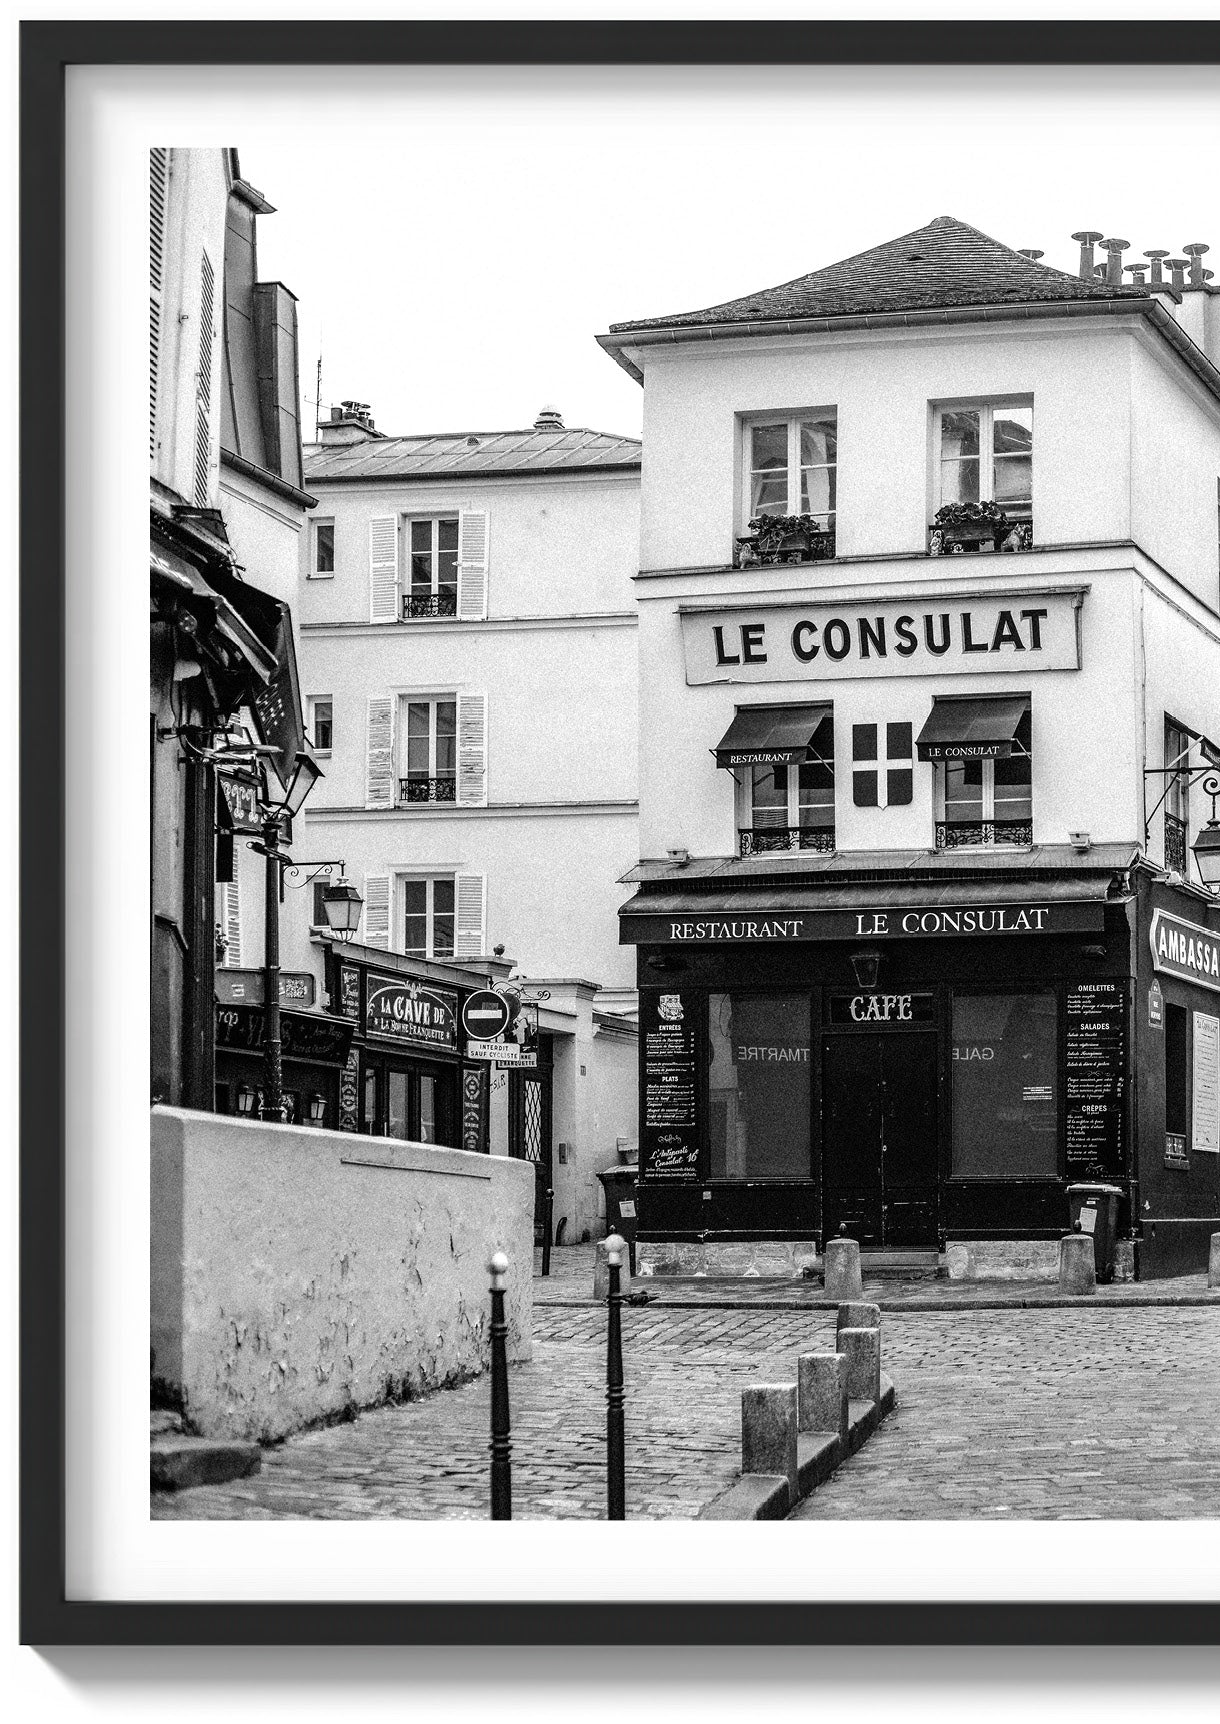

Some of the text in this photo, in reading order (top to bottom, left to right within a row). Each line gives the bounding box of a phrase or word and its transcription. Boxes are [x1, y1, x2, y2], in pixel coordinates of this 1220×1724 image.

[713, 608, 1049, 667] LE CONSULAT
[729, 751, 793, 765] RESTAURANT
[928, 745, 999, 758] LE CONSULAT
[669, 908, 1049, 940] RESTAURANT LE CONSULAT
[1077, 984, 1115, 992] OMELETTES
[381, 996, 445, 1025] LA CAVE DE
[849, 995, 913, 1022] CAFE
[479, 1043, 509, 1052] INTERDIT
[470, 1050, 518, 1059] SAUF CYCLISTE
[1081, 1104, 1108, 1112] CRÊPES
